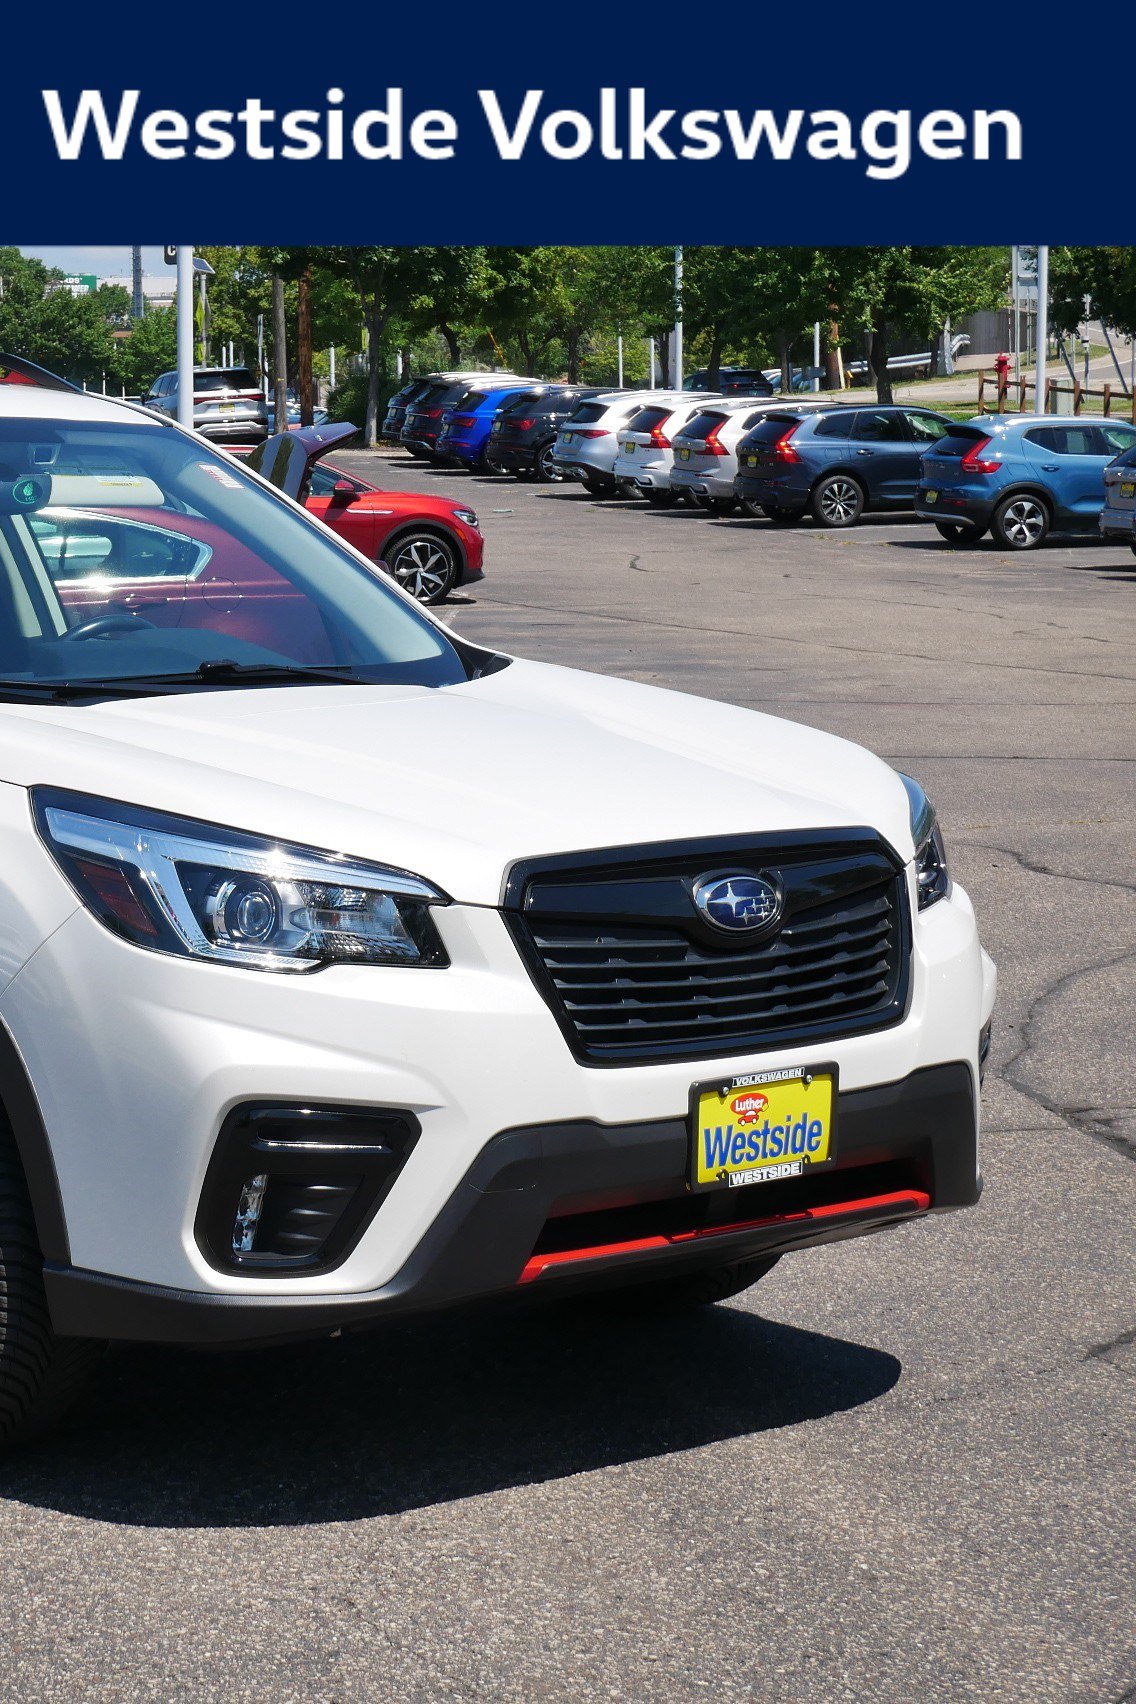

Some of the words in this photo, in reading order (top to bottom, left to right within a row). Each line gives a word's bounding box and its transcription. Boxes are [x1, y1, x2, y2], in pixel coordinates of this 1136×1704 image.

[735, 1068, 802, 1087] VOLKSWAGEN
[735, 1097, 765, 1112] Luther
[704, 1112, 823, 1169] Westside
[731, 1162, 800, 1185] WESTSIDE
